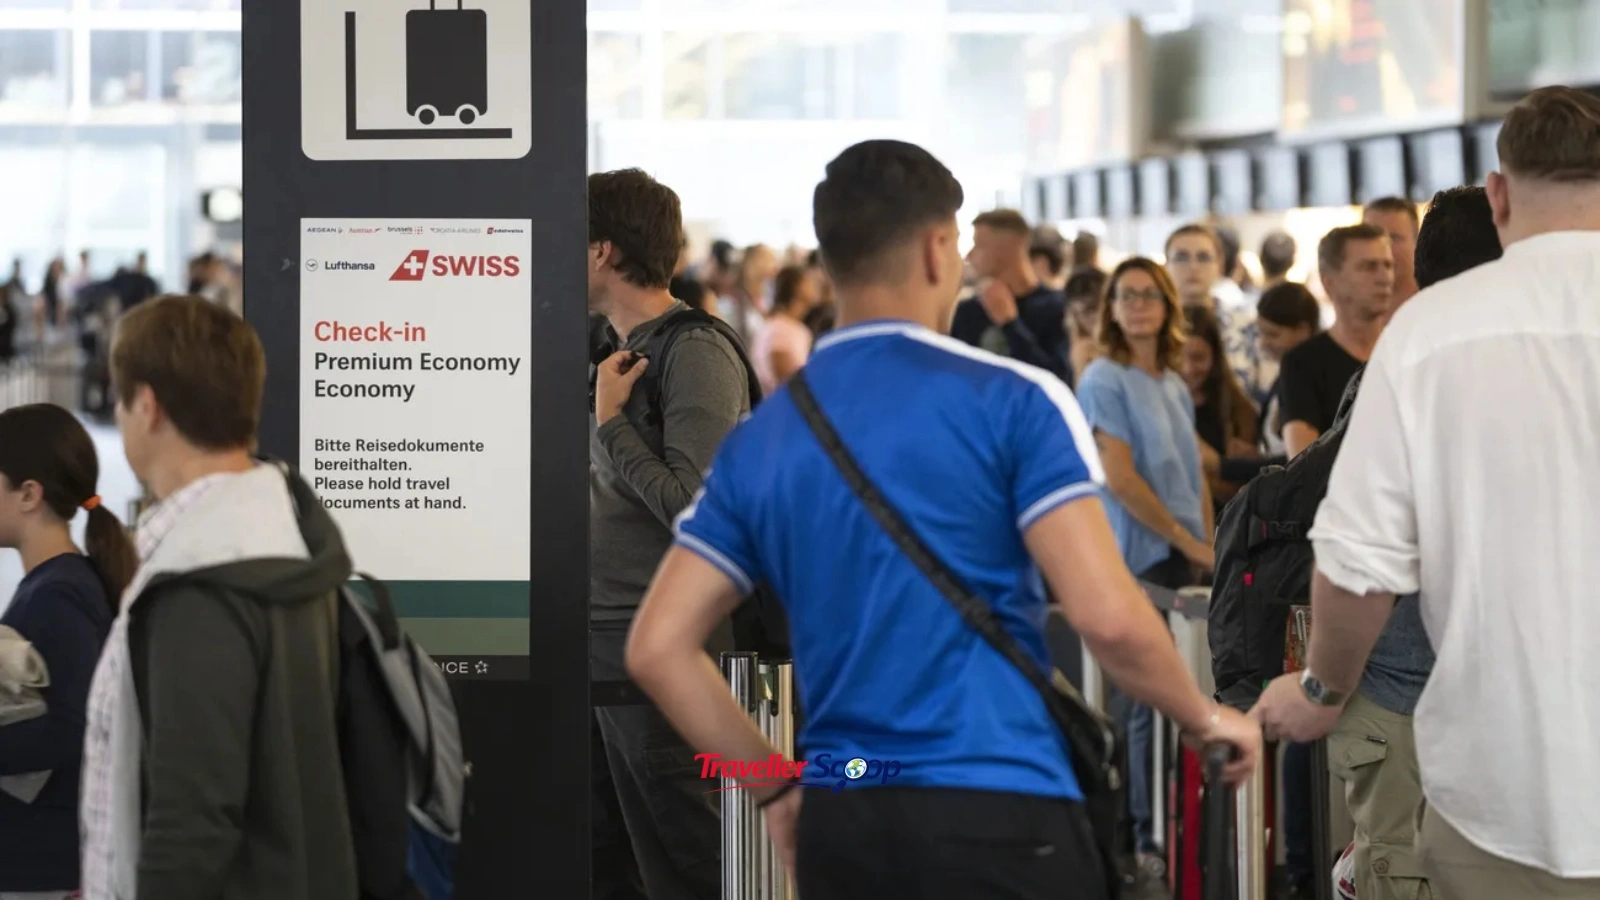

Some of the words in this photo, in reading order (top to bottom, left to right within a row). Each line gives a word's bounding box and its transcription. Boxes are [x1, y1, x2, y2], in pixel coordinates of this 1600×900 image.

[324, 261, 375, 270] Lufthansa
[432, 255, 520, 277] SWISS
[314, 320, 426, 342] Check-in
[314, 352, 413, 371] Premium
[420, 352, 521, 375] Economy
[314, 379, 415, 402] Economy
[314, 438, 351, 452] Bitte
[355, 438, 485, 452] Reisedokumente
[314, 457, 412, 471] bereithalten.
[314, 476, 364, 490] Please
[368, 476, 401, 490] hold
[406, 476, 450, 490] travel
[404, 497, 420, 509] at
[424, 496, 467, 509] hand.
